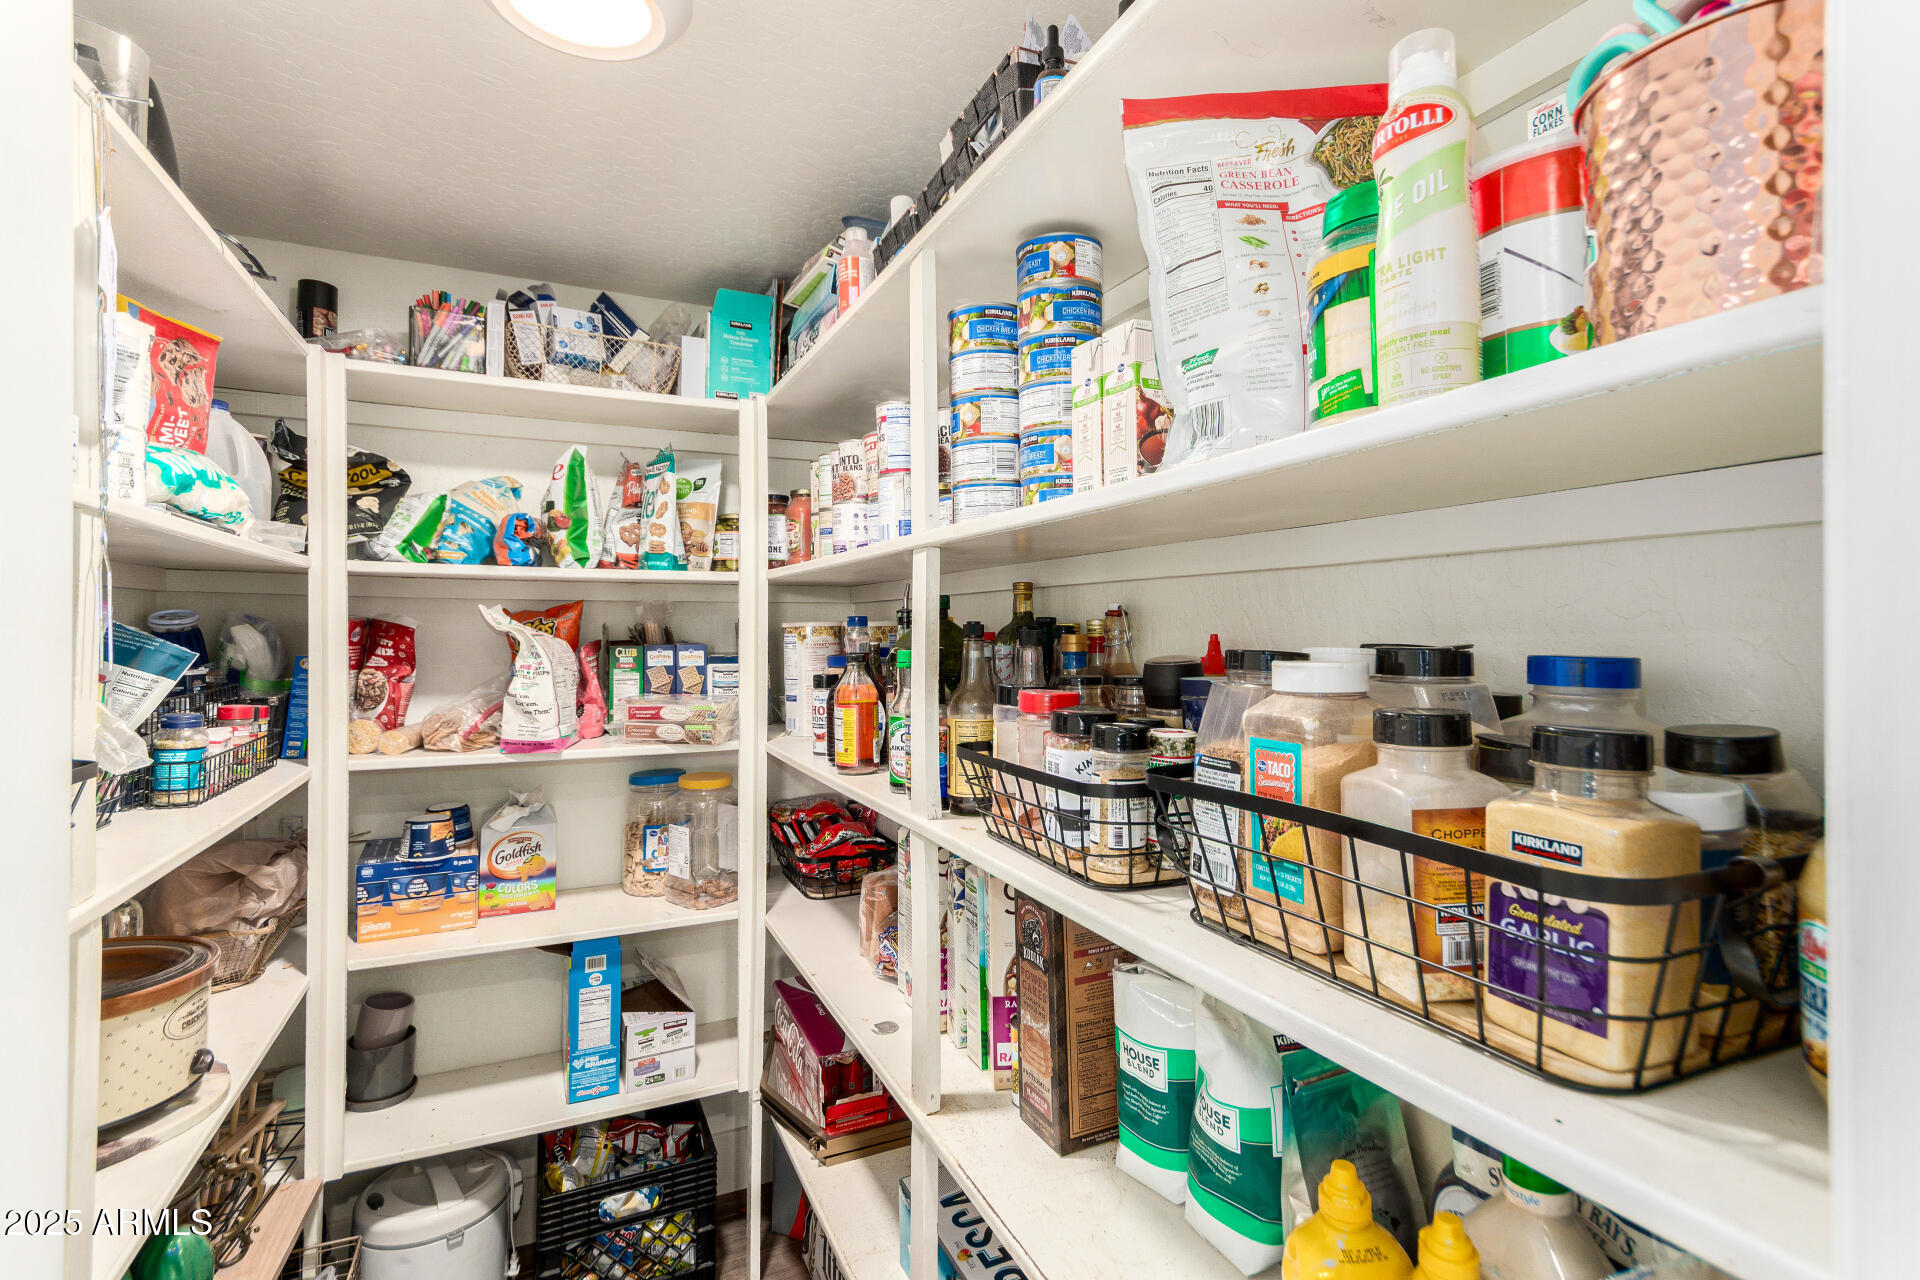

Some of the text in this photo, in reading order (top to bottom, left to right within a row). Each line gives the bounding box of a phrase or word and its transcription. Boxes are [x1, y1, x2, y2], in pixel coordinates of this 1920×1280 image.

[1532, 105, 1563, 128] CORN
[1532, 116, 1564, 138] FLAKES
[1148, 165, 1209, 178] Nutrition Facts
[1219, 167, 1293, 180] GREEN BEAN
[1220, 176, 1300, 191] CASSEROLE
[1412, 169, 1449, 204] OIL
[1153, 190, 1178, 205] Calories
[1398, 247, 1446, 269] LIGHT
[1071, 289, 1097, 299] KIRKLAND
[984, 308, 1013, 317] KIRKLAND
[1062, 306, 1087, 315] CHICKEN
[976, 325, 1000, 333] CHICKEN
[1409, 332, 1427, 342] your
[1429, 327, 1451, 337] meal
[1045, 337, 1076, 345] KIRKLAND
[1413, 340, 1436, 348] FREE
[1036, 353, 1061, 364] CHICKEN
[840, 454, 859, 466] INTO
[842, 464, 863, 473] BEANS
[615, 647, 638, 658] CLUB
[649, 653, 672, 661] Graham
[681, 653, 703, 661] Graham
[121, 670, 150, 682] Nutrition
[1266, 760, 1292, 779] TACO
[1257, 774, 1292, 792] Seasoning
[495, 840, 542, 866] Goldfish
[1513, 833, 1582, 858] KIRKLAND
[458, 858, 473, 867] pack
[497, 880, 540, 894] COLORS
[1509, 903, 1584, 936] Granlated
[1500, 918, 1596, 964] GARLIC
[1023, 945, 1045, 972] KODIAK
[1020, 966, 1048, 993] POWER
[1022, 980, 1048, 1004] CAKES
[1122, 1041, 1161, 1072] HOUSE
[1127, 1058, 1155, 1079] BLEND
